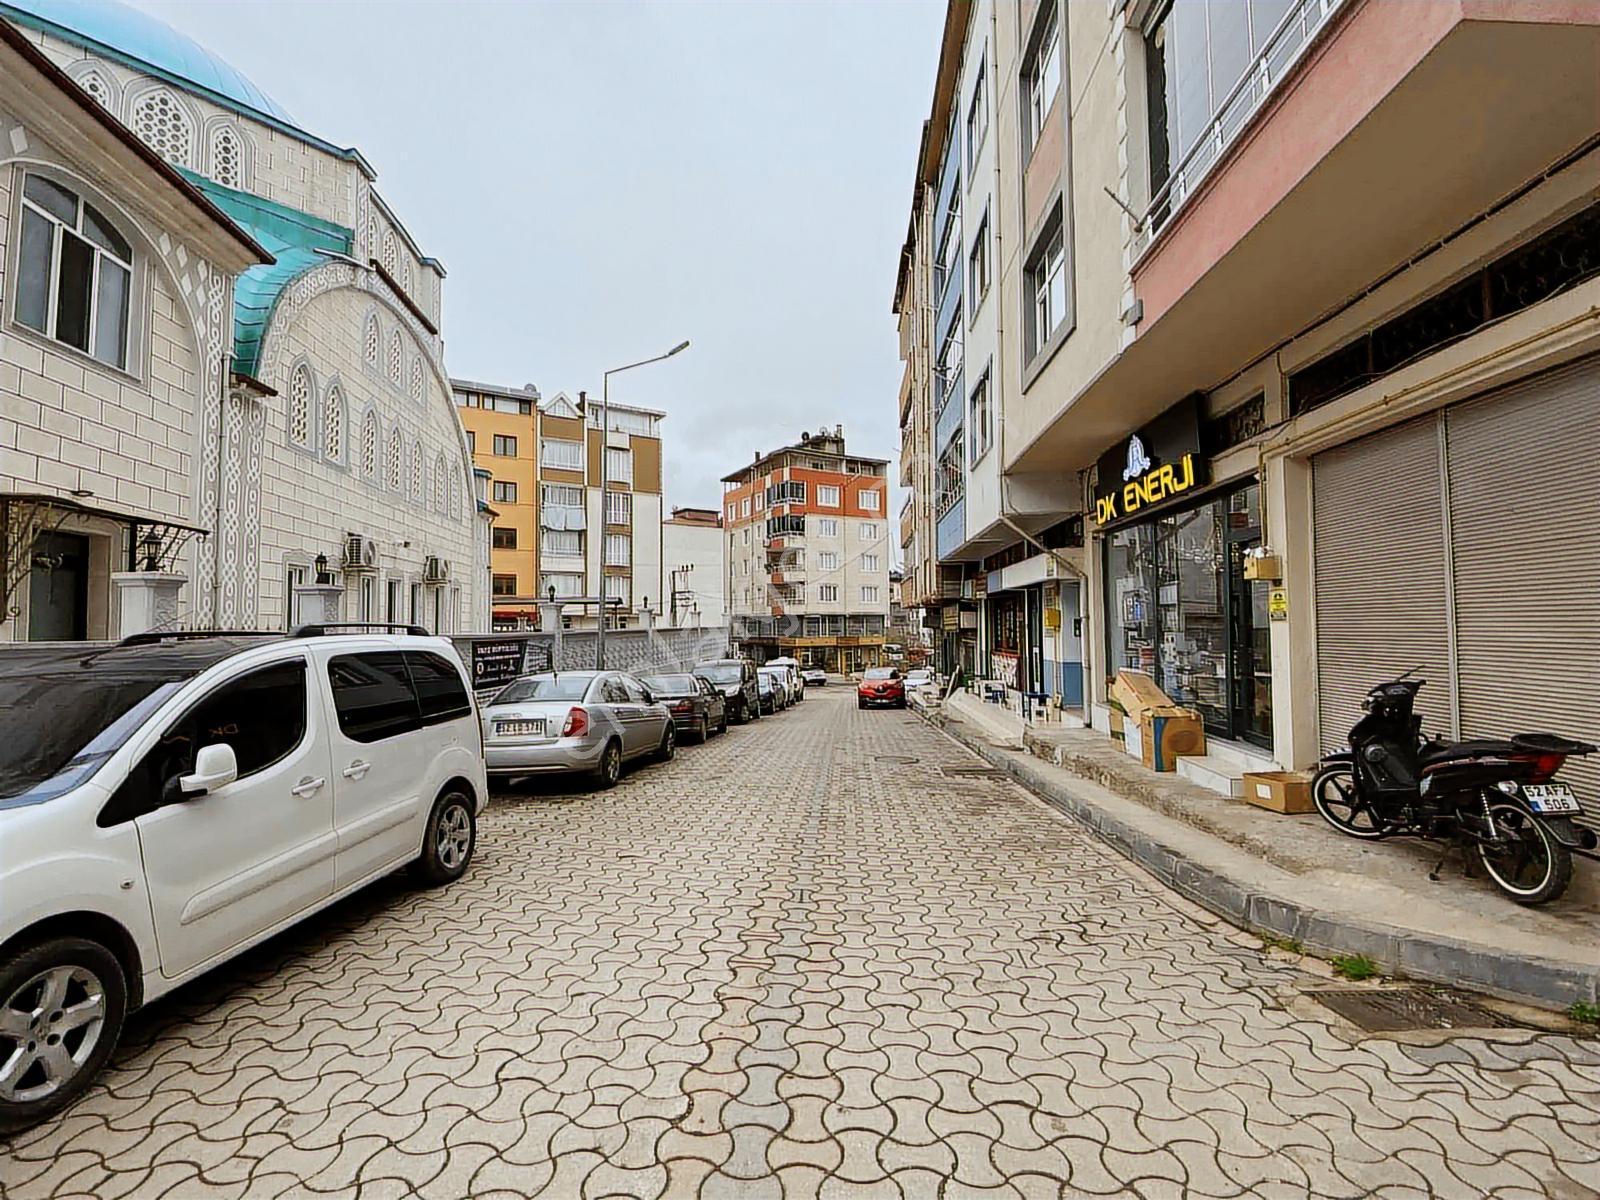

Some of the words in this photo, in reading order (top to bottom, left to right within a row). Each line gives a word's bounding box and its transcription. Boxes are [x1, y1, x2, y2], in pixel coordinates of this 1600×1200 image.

[1096, 492, 1118, 525] DK
[1525, 785, 1544, 797] 52
[1544, 784, 1570, 796] AFZ
[1544, 799, 1570, 810] 506
